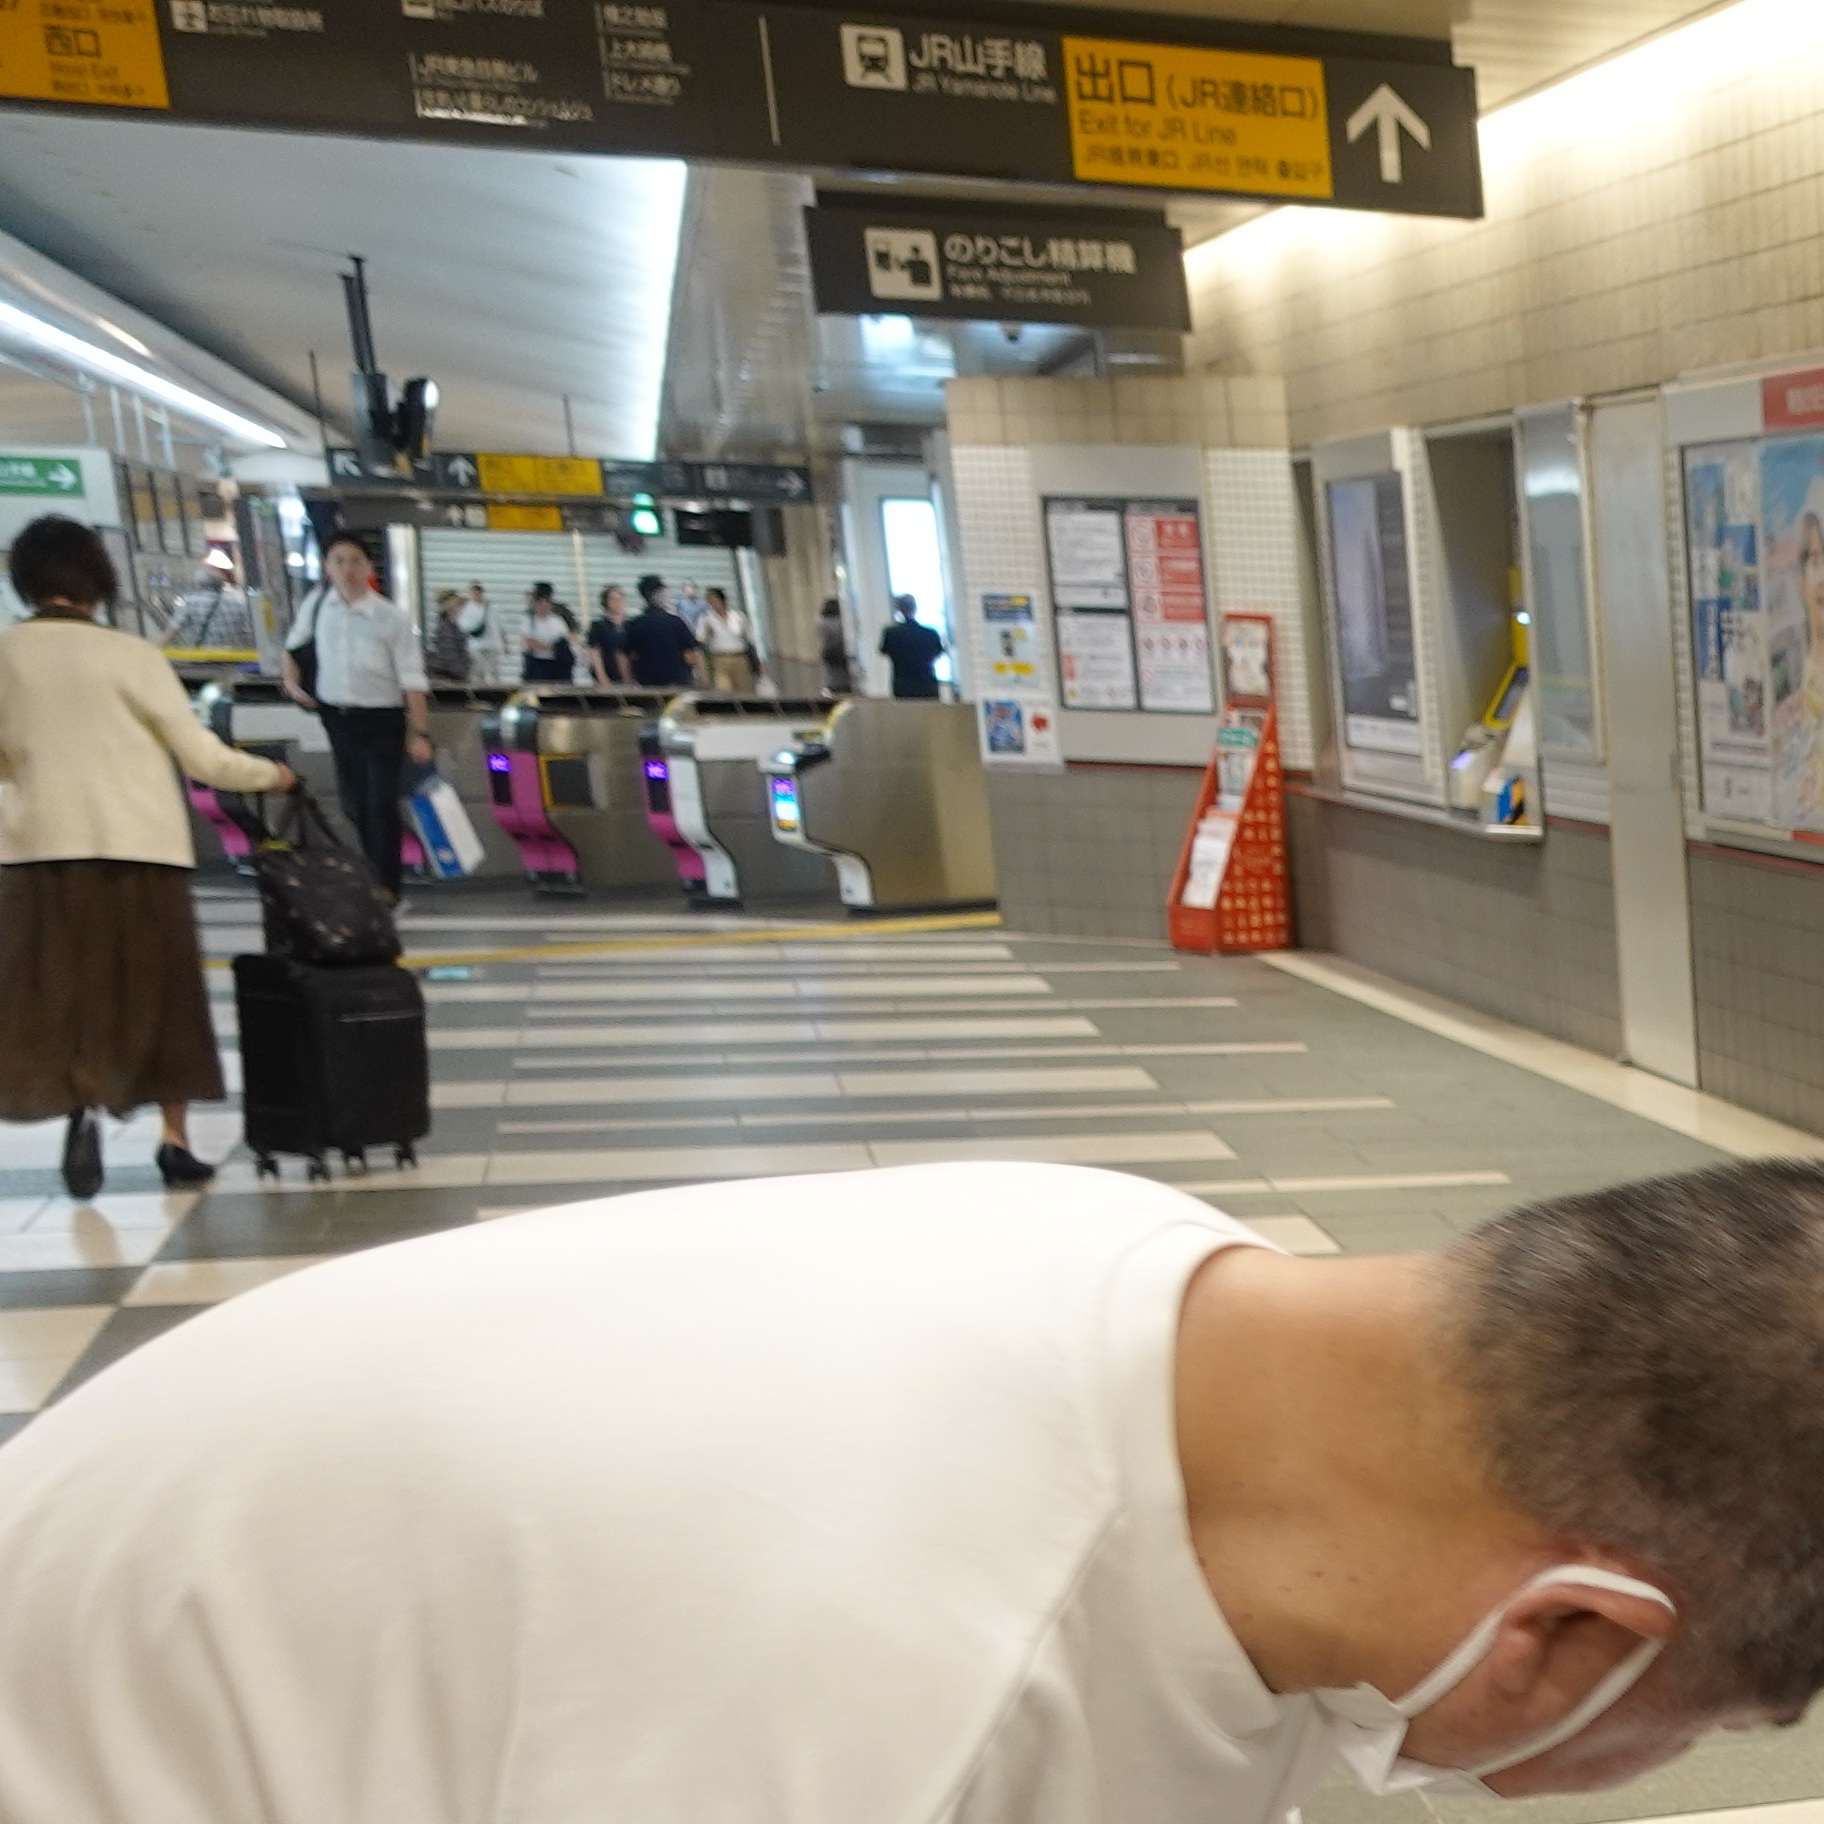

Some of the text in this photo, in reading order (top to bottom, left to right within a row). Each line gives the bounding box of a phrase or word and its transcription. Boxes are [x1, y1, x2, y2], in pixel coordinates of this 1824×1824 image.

[909, 34, 1047, 79] JR山手線
[1074, 52, 1154, 105] 出口
[1157, 116, 1187, 142] JR
[944, 234, 1137, 274] のりこし精算機
